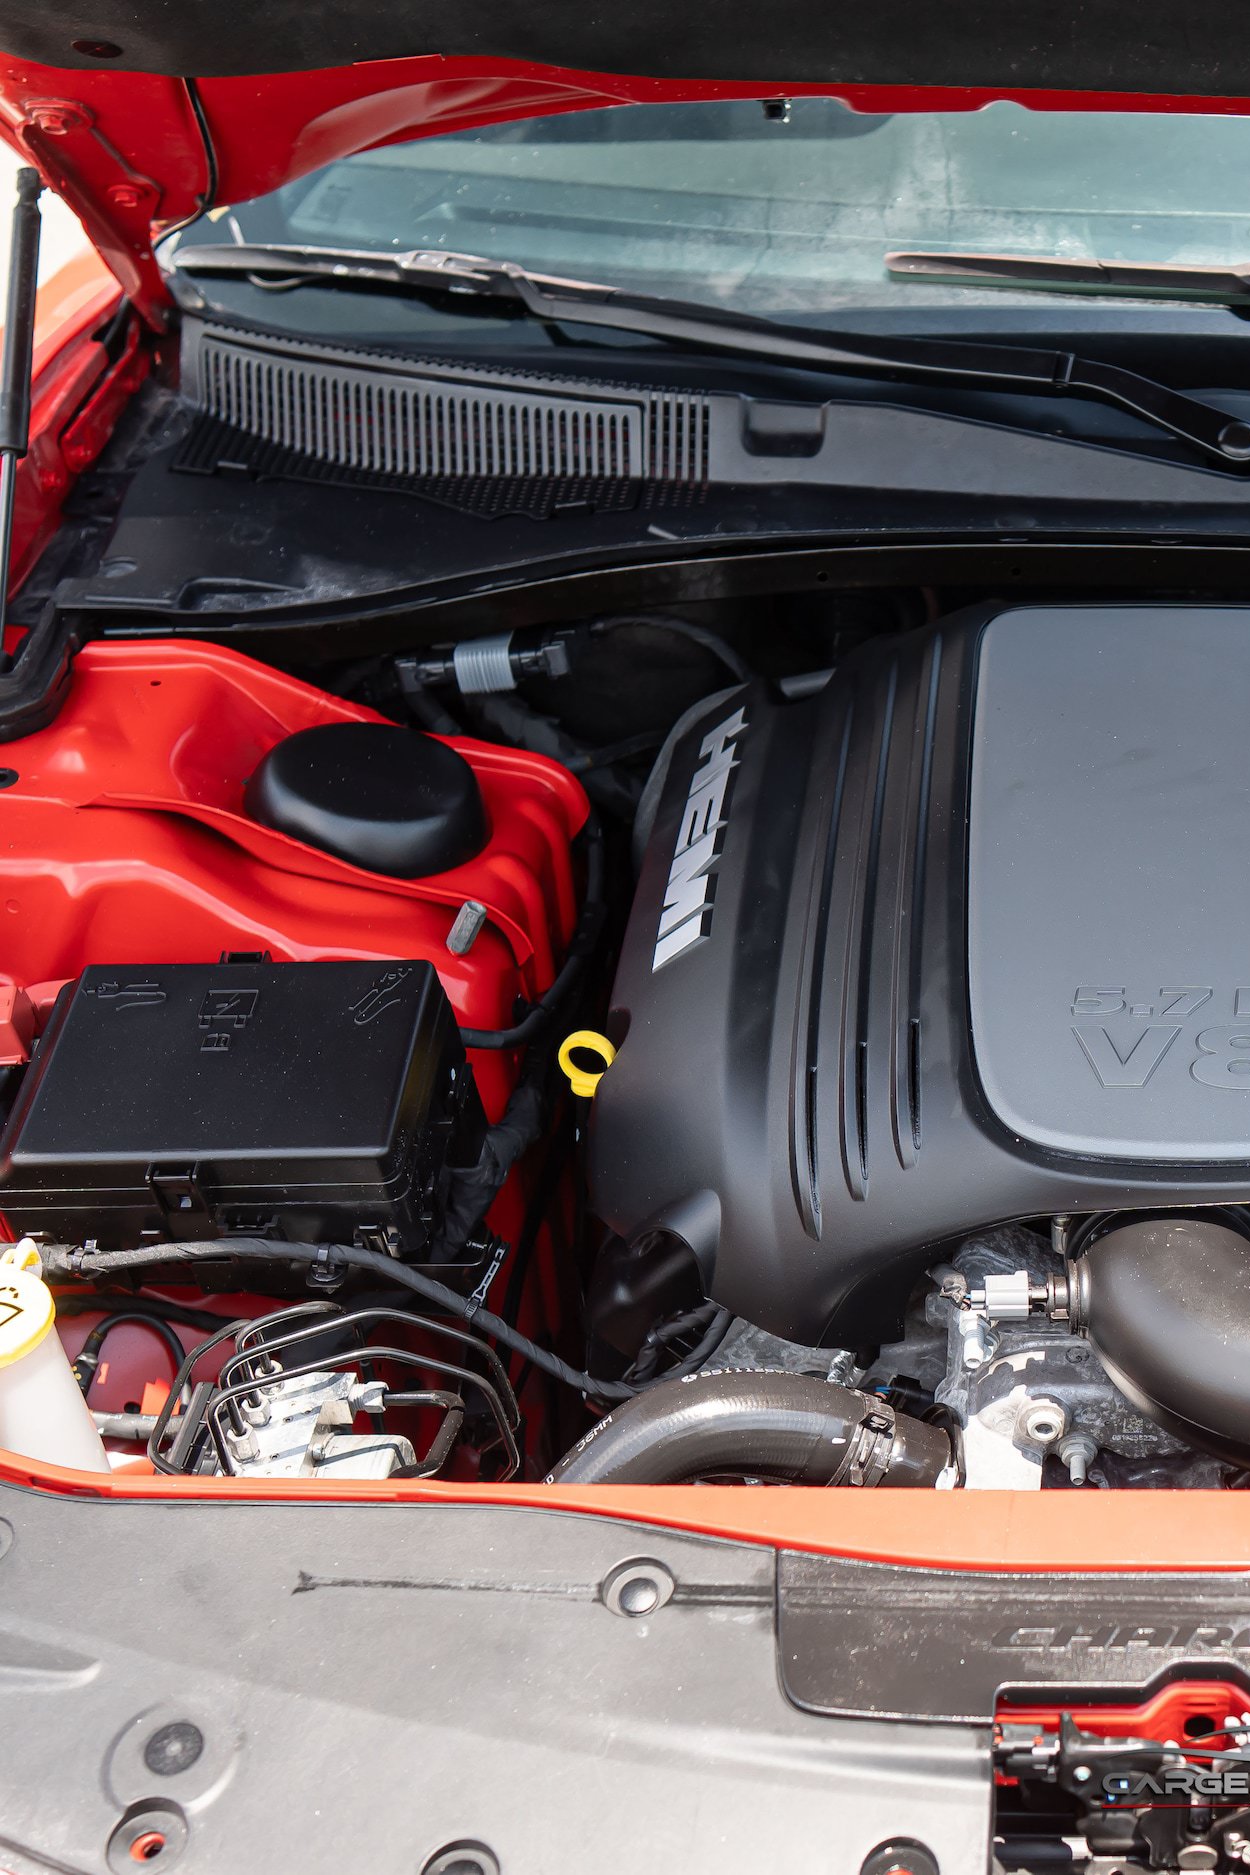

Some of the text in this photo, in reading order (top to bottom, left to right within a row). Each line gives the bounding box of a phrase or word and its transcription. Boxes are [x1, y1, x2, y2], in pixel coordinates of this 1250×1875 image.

[651, 704, 748, 974] HEMI
[1069, 984, 1214, 1018] 5.7
[576, 1414, 613, 1452] 36MM
